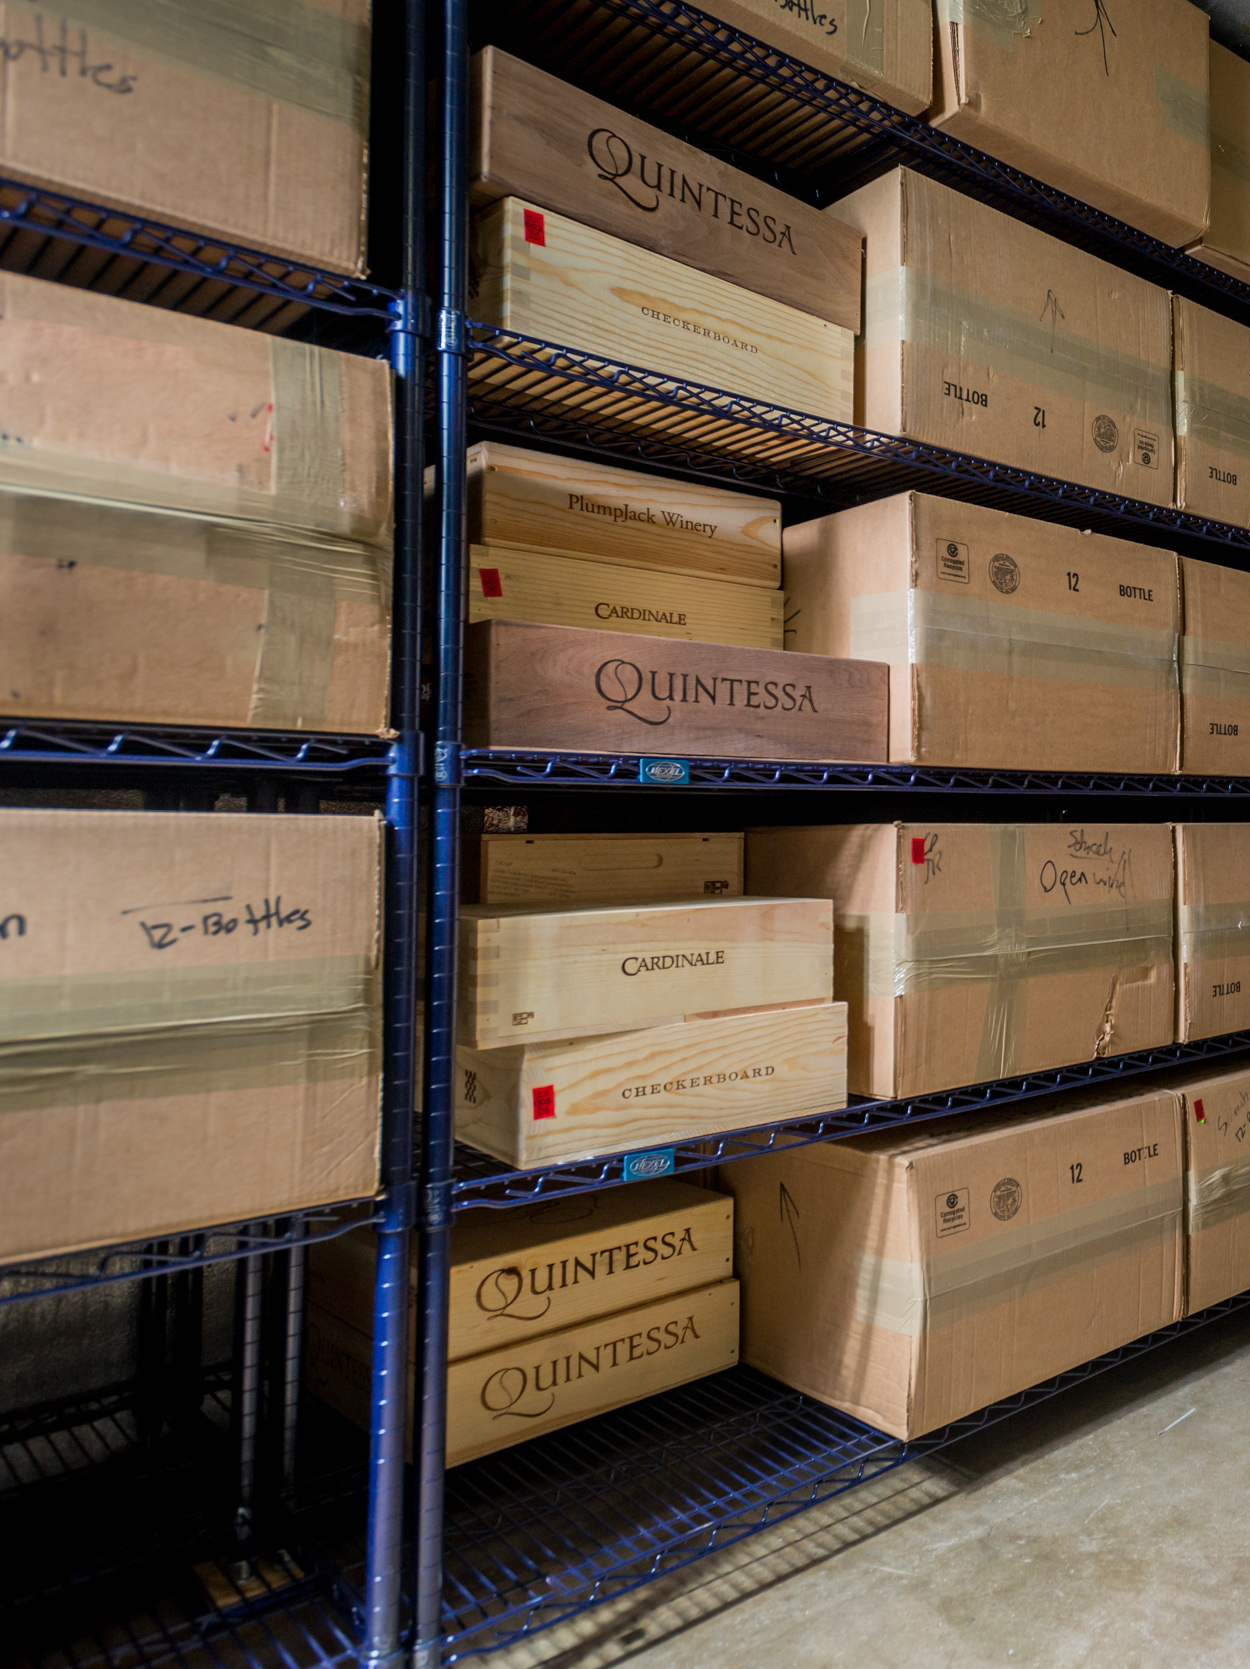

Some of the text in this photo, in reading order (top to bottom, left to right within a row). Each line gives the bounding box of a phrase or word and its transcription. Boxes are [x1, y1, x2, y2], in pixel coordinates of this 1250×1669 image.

[587, 127, 797, 255] QUINTESSA
[641, 306, 759, 355] CHECKERBOARD
[943, 380, 1047, 429] BOTTLE 12
[1208, 465, 1238, 486] BOTTLE
[567, 493, 718, 539] PlumpJack Winery
[1066, 571, 1154, 603] 12 BOTTLE
[594, 602, 687, 626] CARDINALE
[594, 658, 819, 726] QUINTESSA
[1209, 722, 1238, 737] BOTTLE
[650, 766, 682, 776] NEXEL
[621, 950, 725, 976] CARDINALE
[1212, 981, 1241, 998] BOTTLE
[621, 1065, 776, 1100] CHECKERBOARD
[634, 1158, 666, 1171] NEXEL
[1070, 1142, 1159, 1184] 12 BOTTLE
[475, 1227, 698, 1321] QUINTESSA
[480, 1316, 702, 1422] QUINTESSA
